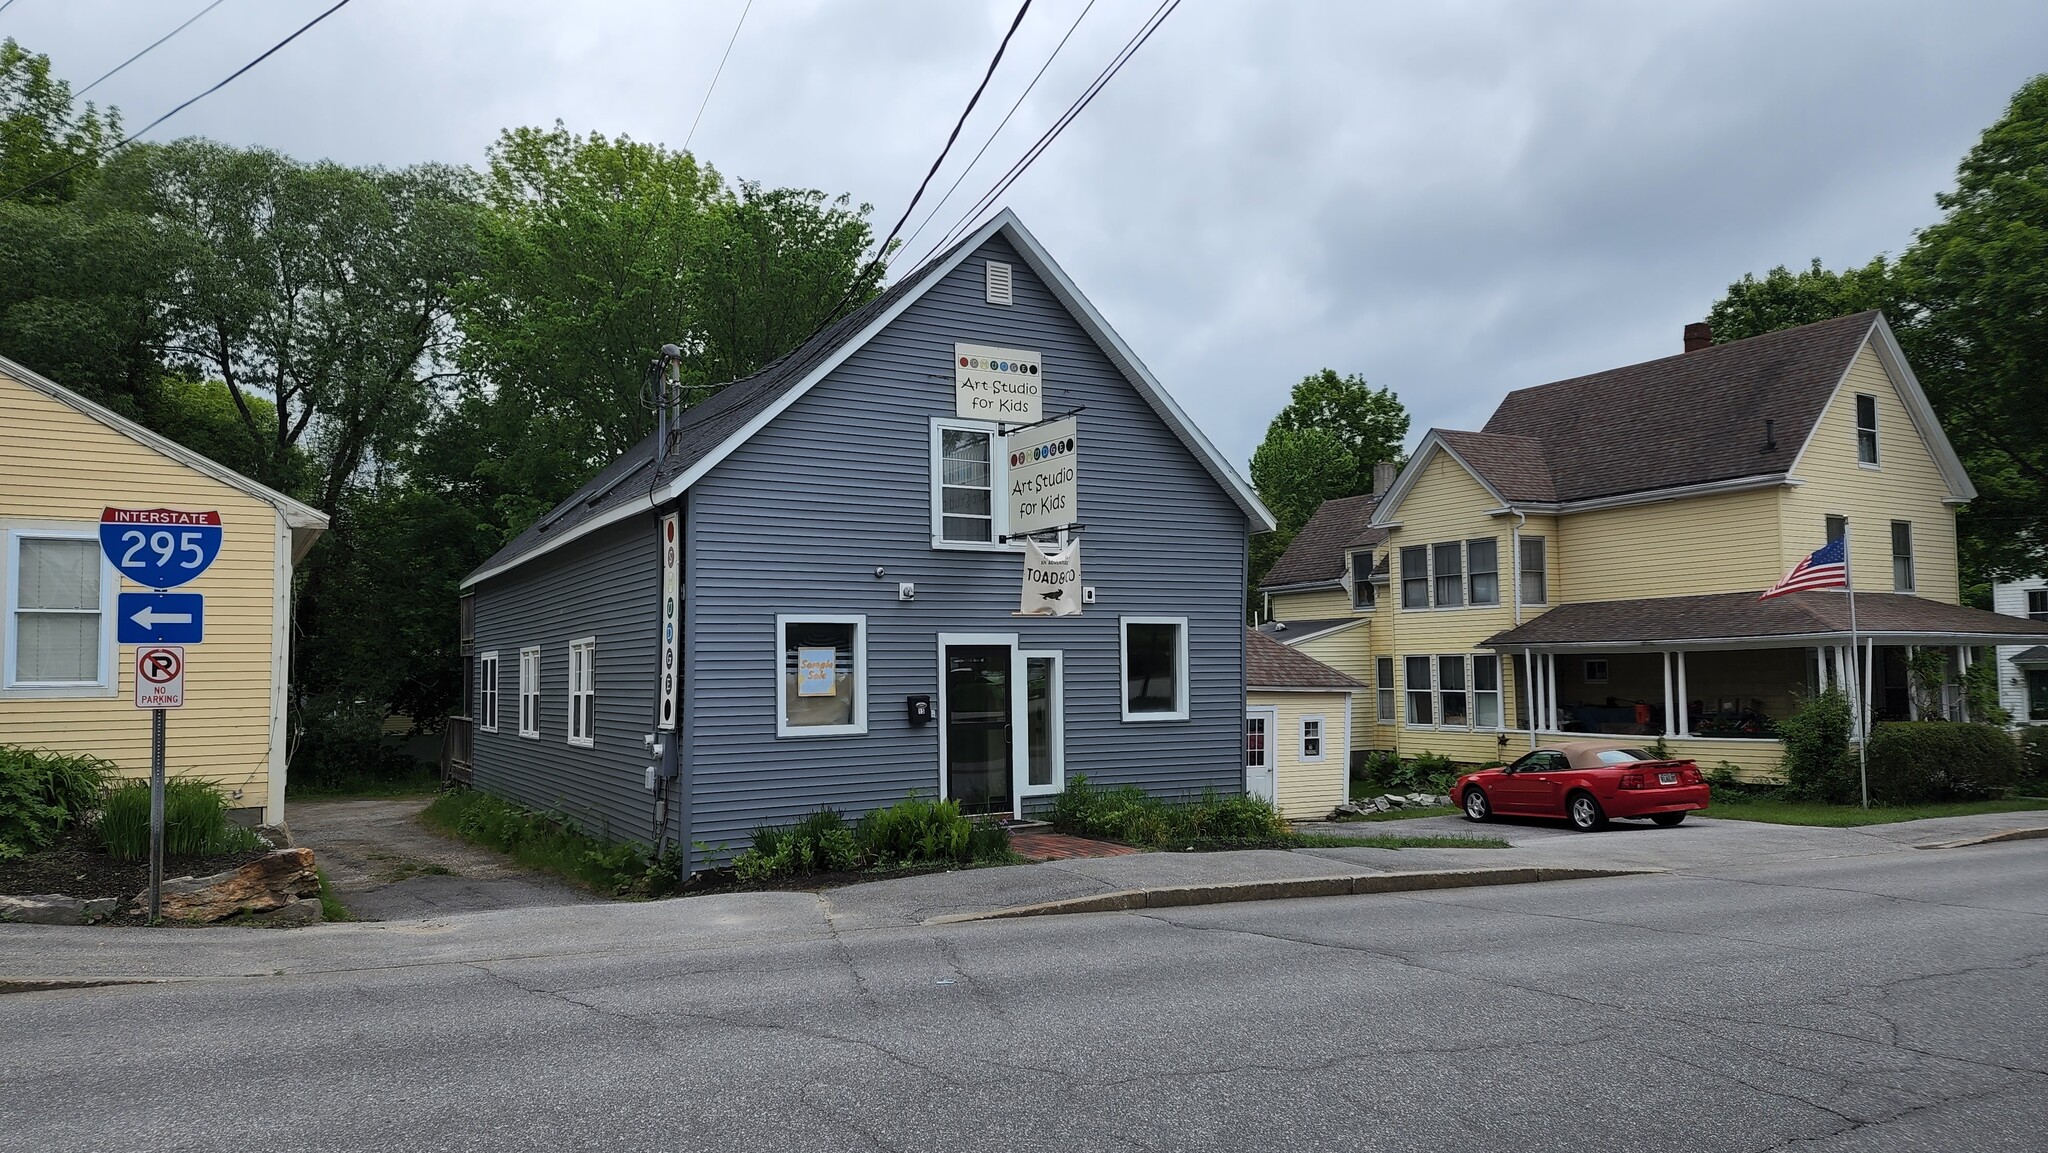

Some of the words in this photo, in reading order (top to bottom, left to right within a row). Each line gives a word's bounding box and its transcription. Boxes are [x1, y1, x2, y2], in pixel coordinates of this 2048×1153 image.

[961, 377, 988, 391] Art
[992, 380, 1038, 395] Studio
[972, 397, 994, 409] for
[999, 399, 1029, 413] Kids
[1011, 480, 1033, 496] Art
[1035, 467, 1074, 494] Studio
[1020, 502, 1037, 519] for
[1040, 493, 1066, 516] Kids
[115, 511, 208, 524] INTERSTATE
[121, 530, 204, 569] 295
[808, 669, 827, 680] Sale
[141, 695, 178, 704] PARKING
